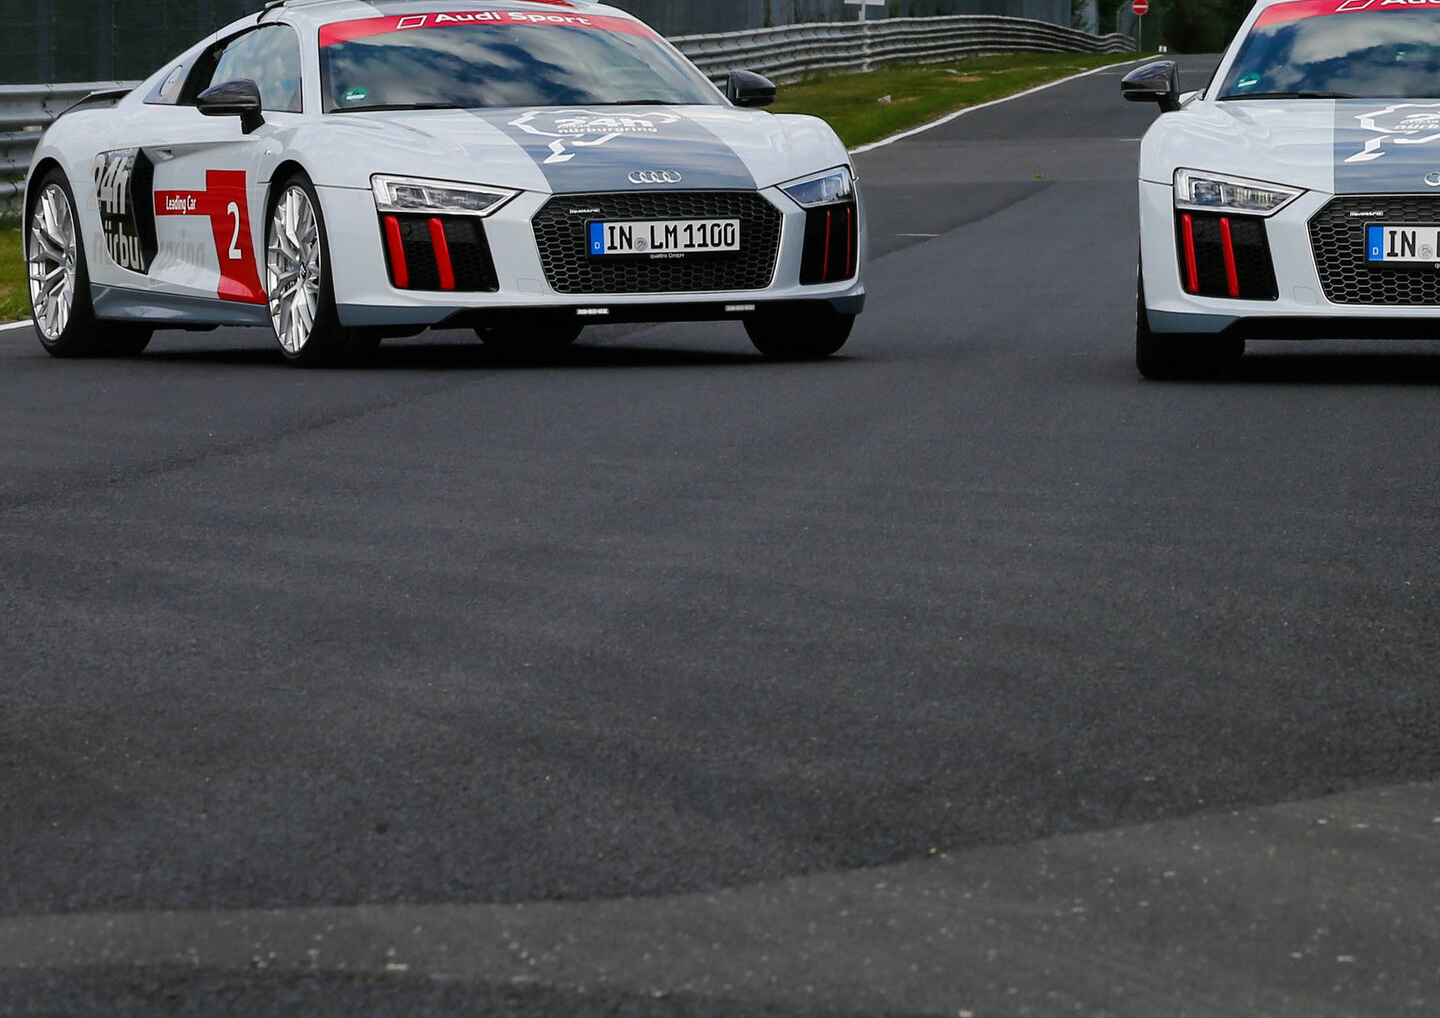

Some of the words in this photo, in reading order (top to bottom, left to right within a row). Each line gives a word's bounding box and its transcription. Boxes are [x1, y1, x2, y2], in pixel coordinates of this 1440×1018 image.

[435, 10, 502, 23] Audi
[507, 11, 592, 26] Sport
[165, 195, 187, 215] Leading
[187, 194, 197, 211] Car
[226, 201, 242, 260] 2
[607, 225, 633, 251] IN
[650, 224, 678, 250] LM
[683, 222, 736, 248] 1100
[1371, 246, 1379, 255] D
[1386, 230, 1416, 257] IN
